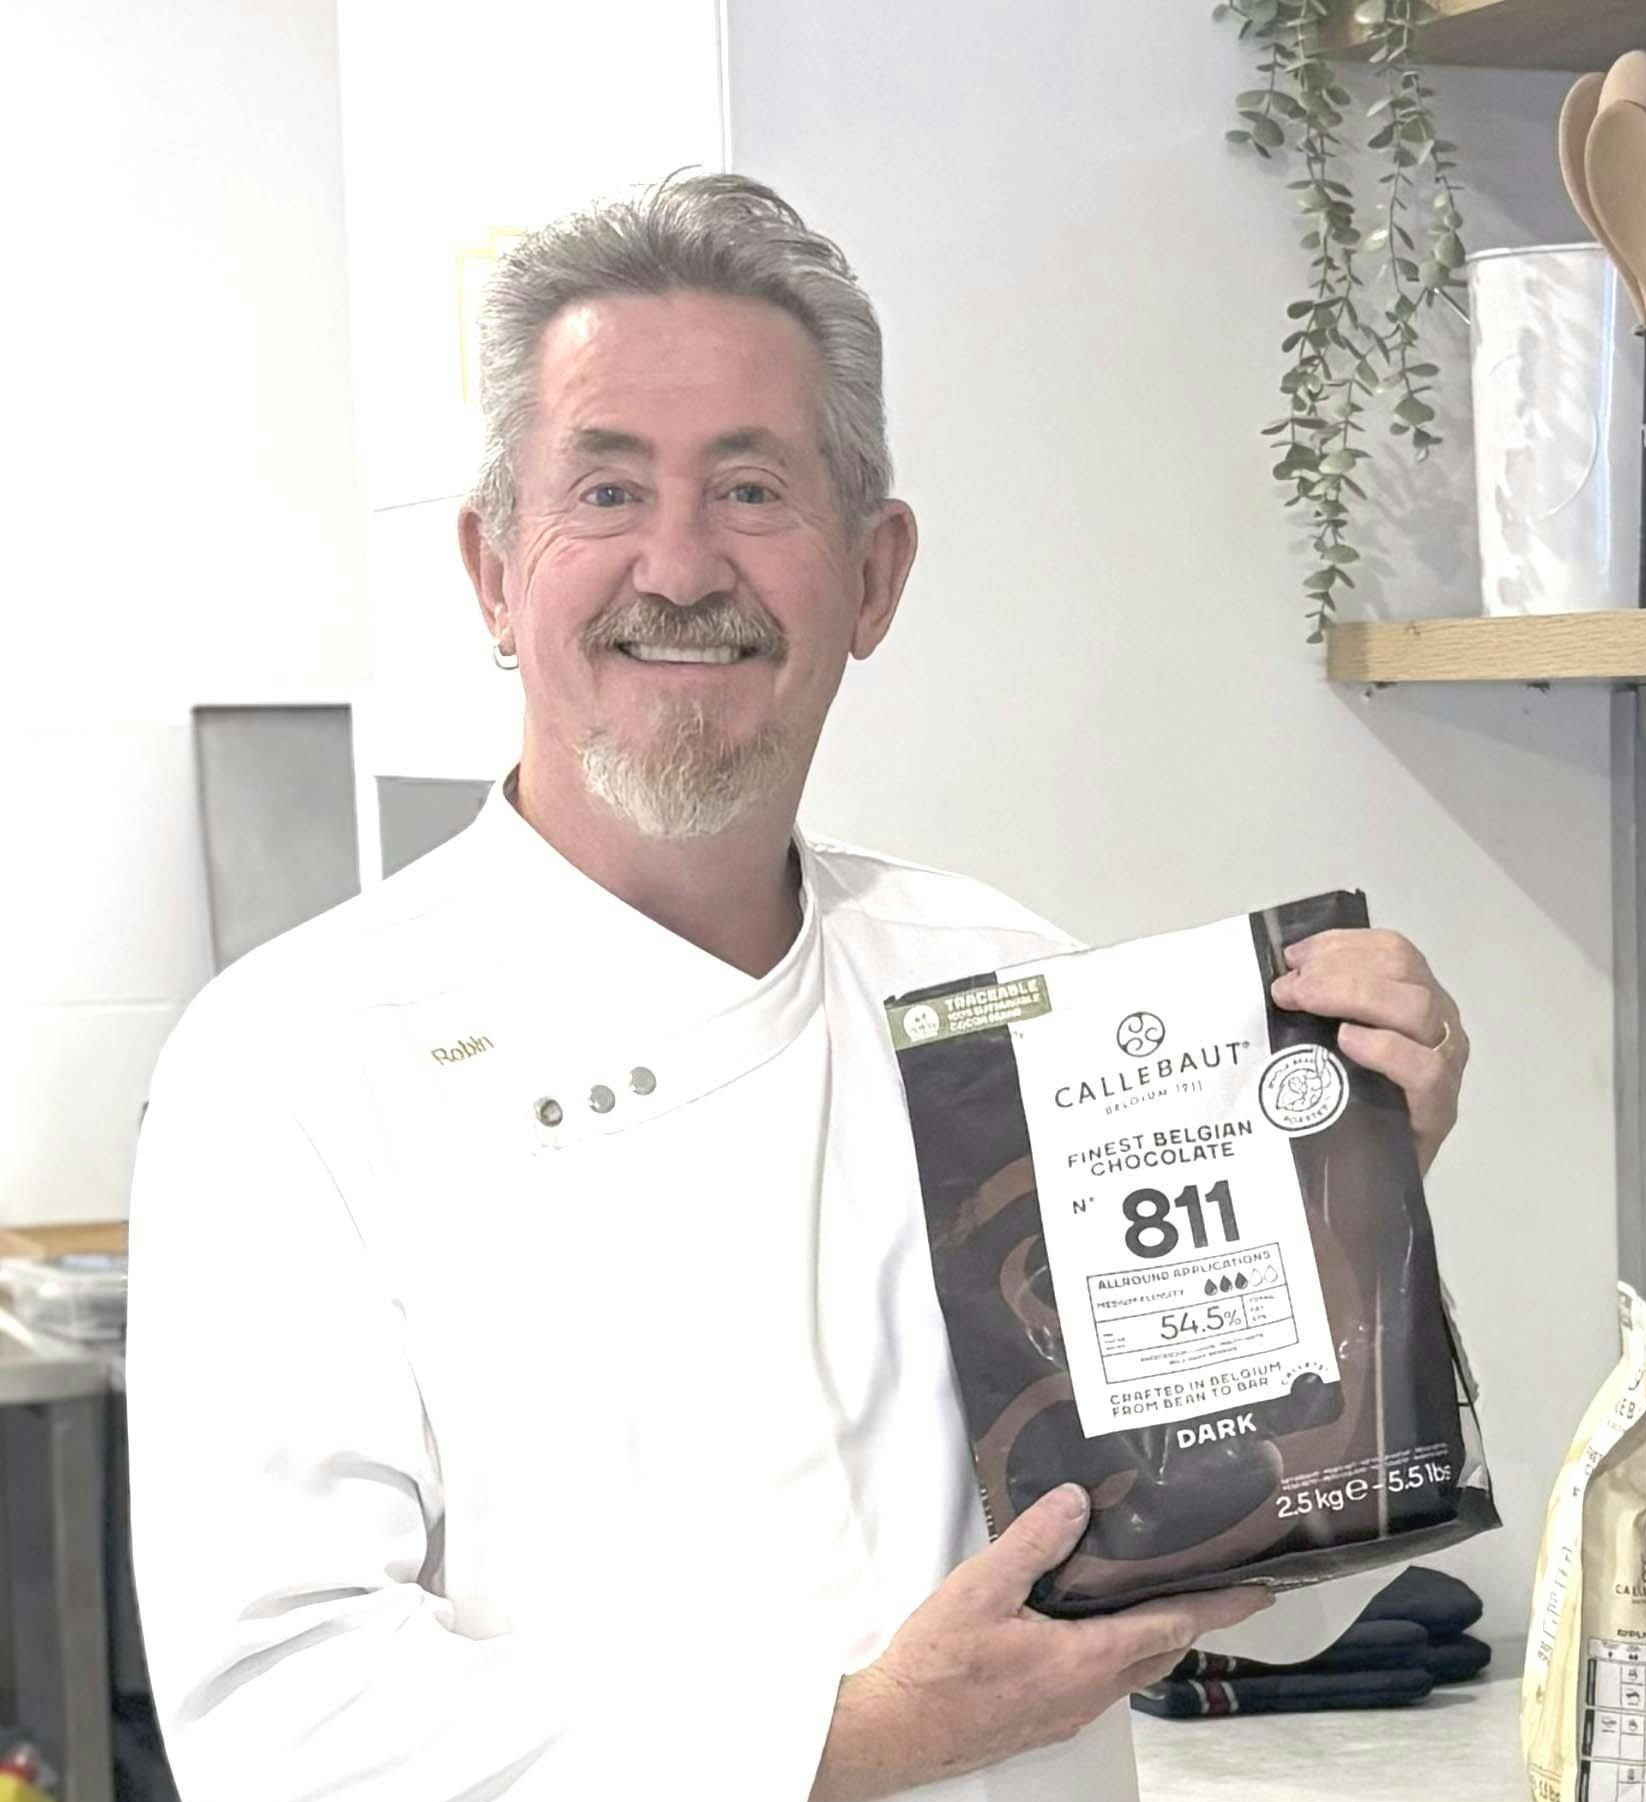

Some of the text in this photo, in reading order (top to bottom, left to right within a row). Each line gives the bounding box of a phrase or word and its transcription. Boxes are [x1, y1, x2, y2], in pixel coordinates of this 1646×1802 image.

[430, 1036, 495, 1066] Robin
[1067, 1120, 1253, 1168] FINEST BELGIAN
[1091, 1141, 1236, 1176] CHOCOLATE
[1122, 1179, 1240, 1259] 811
[1098, 1250, 1271, 1290] ALLROUND APPLICATIONS
[1160, 1305, 1242, 1340] 54.5%
[1110, 1361, 1282, 1406] CRAFTED IN BELGIUM
[1112, 1377, 1269, 1417] FROM BEAN TO BAR
[1176, 1412, 1257, 1449] DARK
